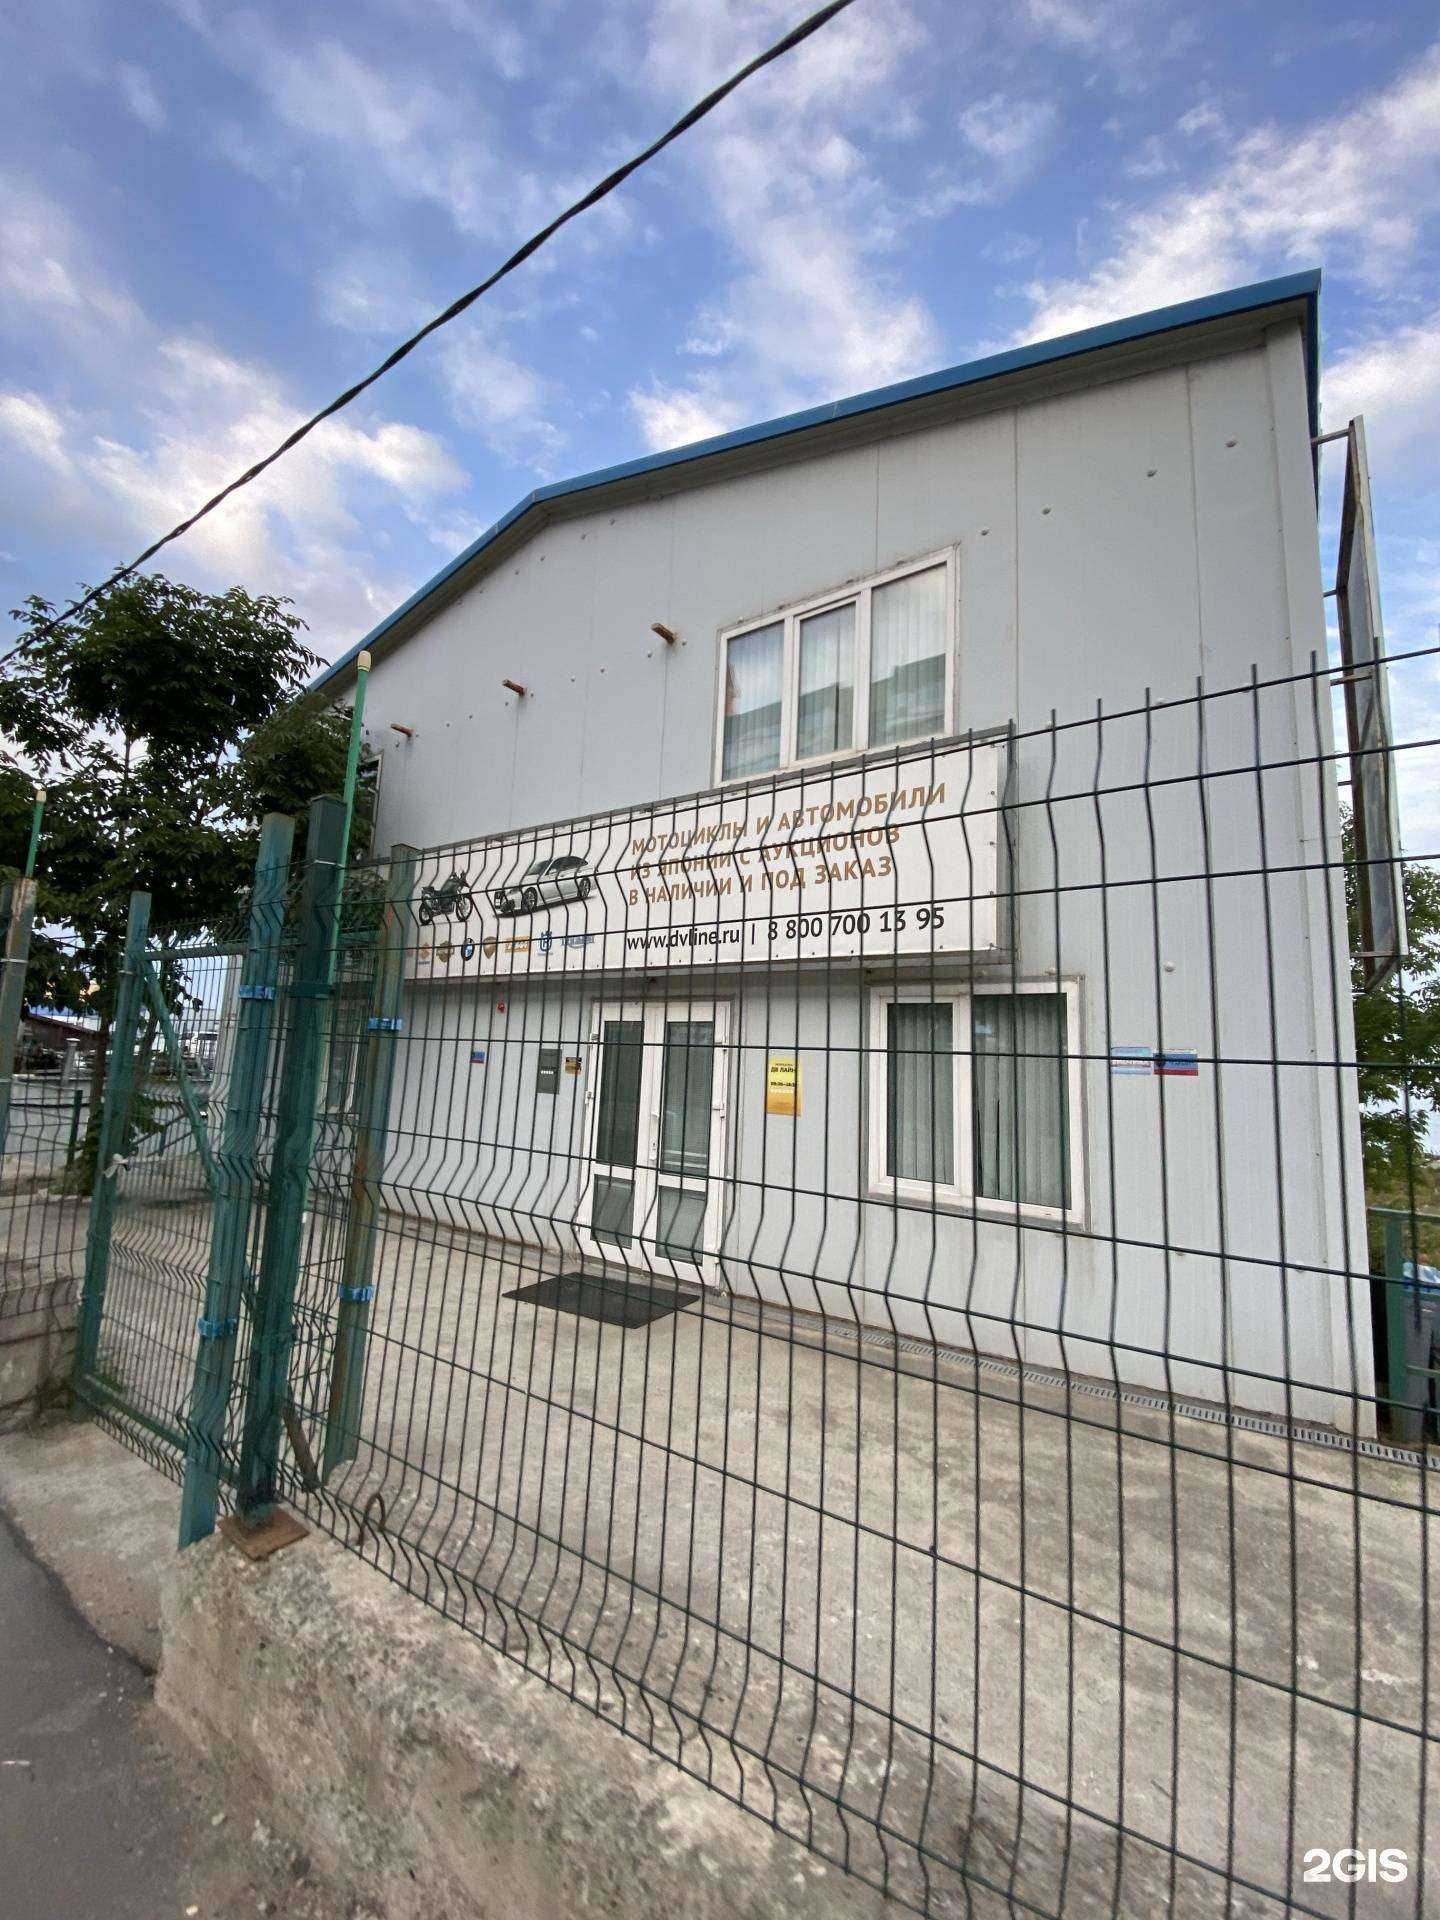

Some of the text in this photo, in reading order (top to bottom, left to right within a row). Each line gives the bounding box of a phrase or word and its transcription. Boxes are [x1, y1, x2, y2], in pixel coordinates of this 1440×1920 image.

[632, 782, 946, 856] МОТОЦИКЛЫ И АВТОМОБИЛИ
[739, 847, 750, 865] С
[758, 823, 901, 864] АУКЦИОНОВ
[628, 856, 893, 906] В НАЛИЧИИ И ПОД ЗАКАЗ
[627, 906, 944, 950] www.dvline.ru 8 800 700 13 95
